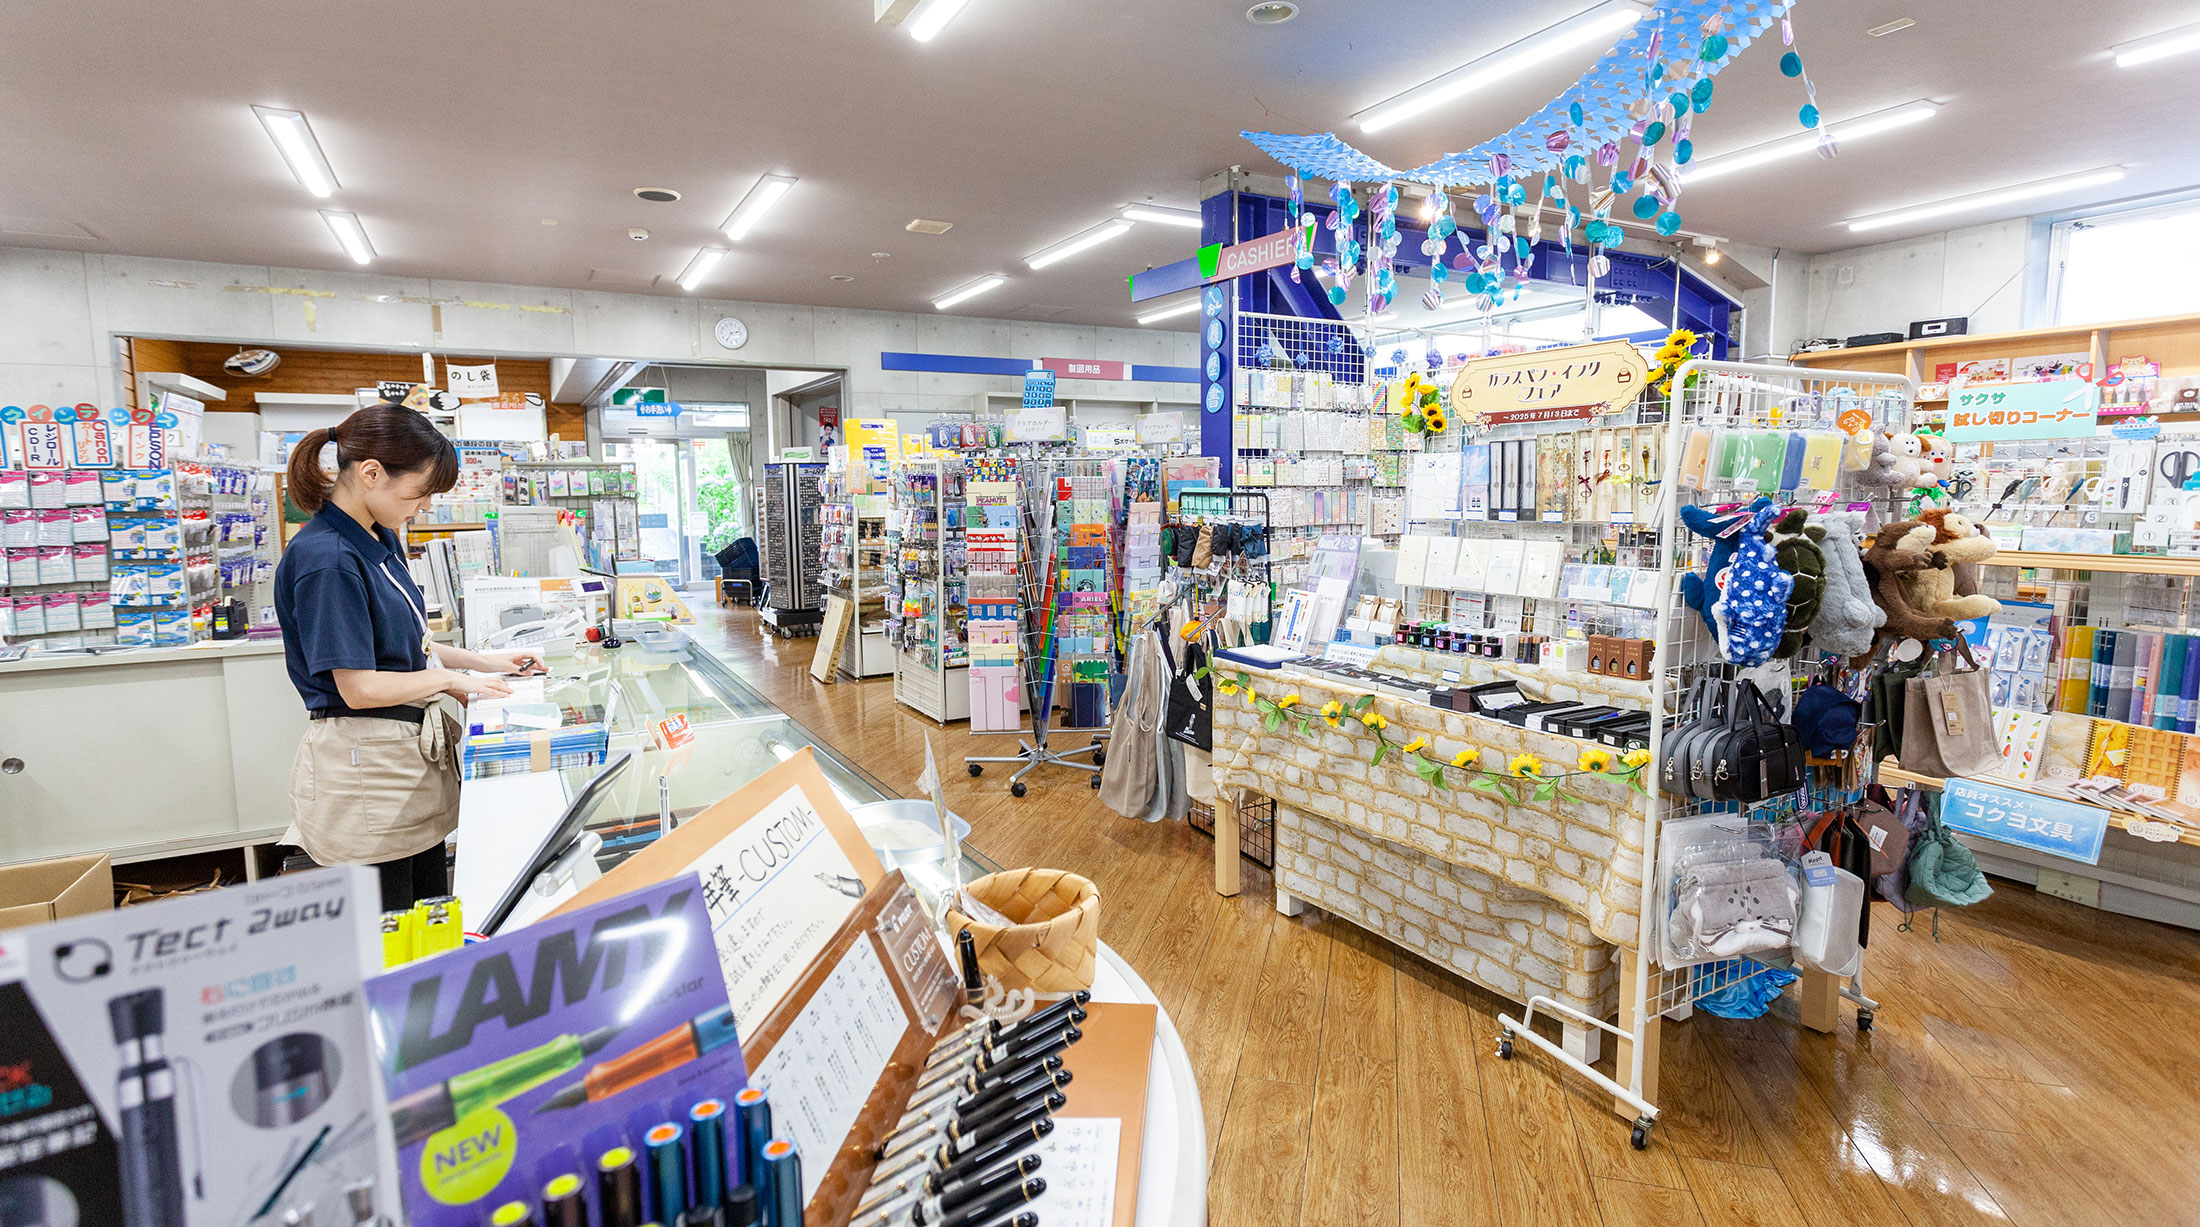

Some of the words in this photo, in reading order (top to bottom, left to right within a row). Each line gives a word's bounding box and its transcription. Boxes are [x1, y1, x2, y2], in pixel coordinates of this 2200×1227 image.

[451, 369, 491, 382] のし袋
[1068, 363, 1101, 375] 製図用品
[1487, 361, 1601, 388] ガラスペン・インク
[1521, 384, 1562, 401] フェア
[1959, 391, 2006, 407] サクサ
[1953, 409, 2091, 428] 試し切りコーナー
[45, 424, 60, 466] レジロール
[92, 420, 108, 463] Canon
[135, 432, 145, 460] インク
[149, 422, 162, 470] EPSON
[1965, 802, 2074, 842] コクヨ文具
[1808, 856, 1822, 864] Kept
[127, 917, 233, 961] Tect
[248, 896, 345, 935] 2way
[898, 904, 914, 927] PILOT
[903, 926, 933, 972] CUSTOM
[433, 1124, 502, 1175] NEW
